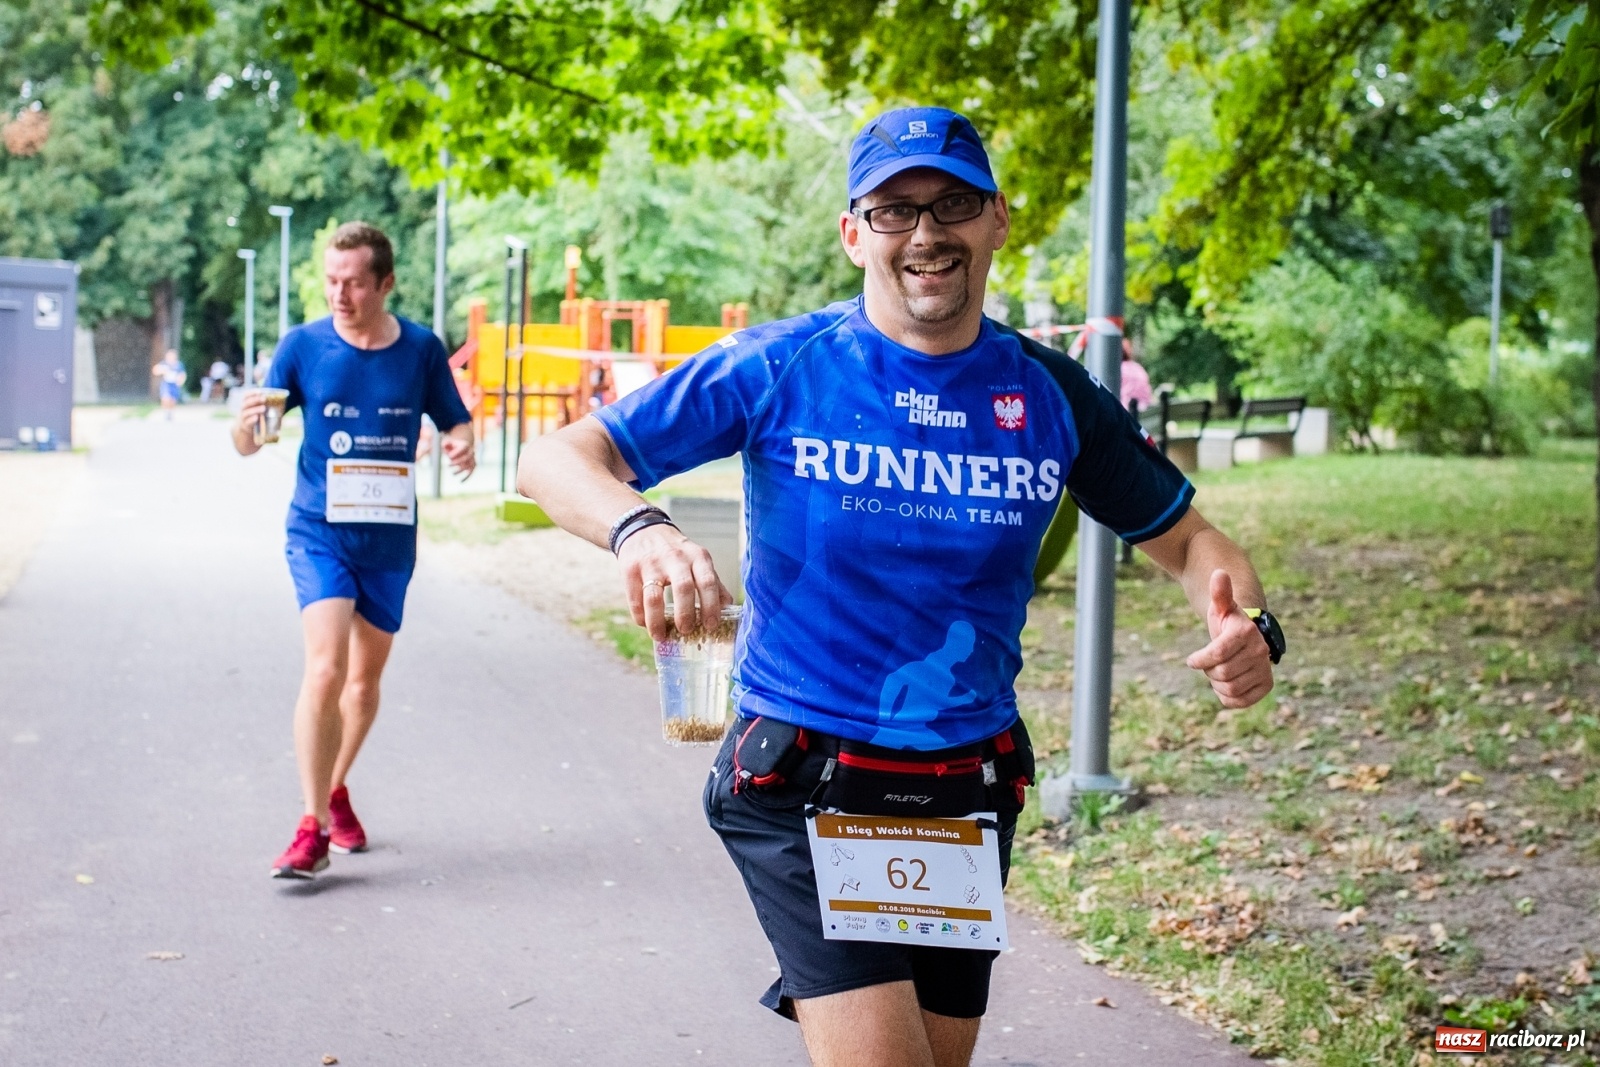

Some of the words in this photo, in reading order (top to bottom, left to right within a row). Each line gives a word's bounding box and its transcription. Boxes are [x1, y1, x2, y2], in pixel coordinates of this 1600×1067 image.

[792, 437, 1061, 502] RUNNERS
[361, 482, 383, 498] 26
[966, 507, 1023, 526] TEAM
[846, 825, 873, 836] Bieg
[876, 825, 914, 836] Wokół
[917, 827, 960, 839] Komina
[886, 857, 931, 891] 62
[878, 905, 915, 914] 03.08.2019
[917, 907, 946, 916] Racibórz
